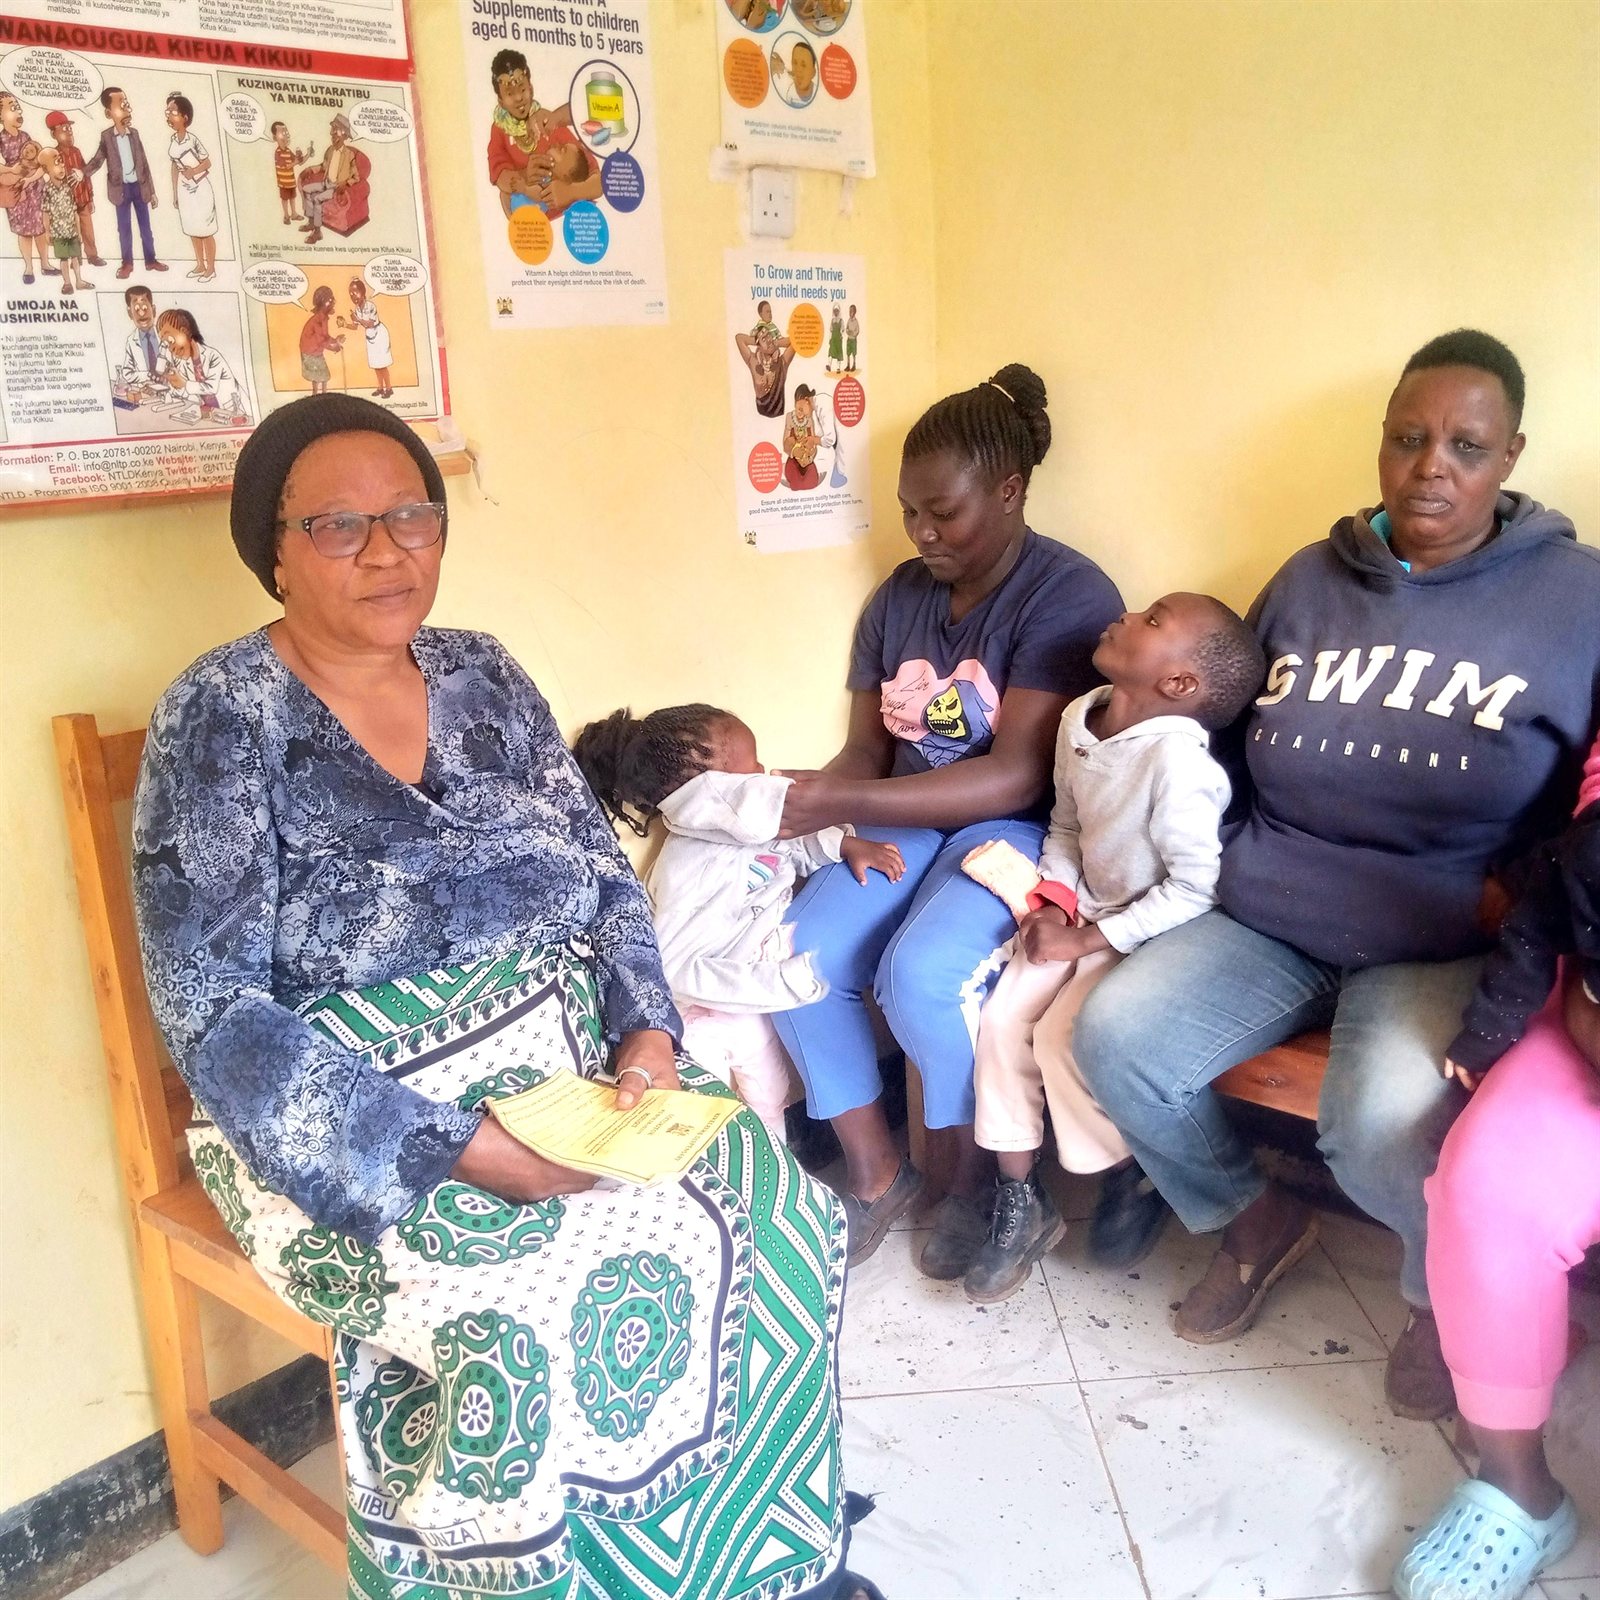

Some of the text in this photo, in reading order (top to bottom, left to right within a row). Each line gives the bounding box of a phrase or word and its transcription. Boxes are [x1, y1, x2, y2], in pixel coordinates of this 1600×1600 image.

[47, 5, 81, 15] matibabu
[162, 11, 170, 19] ya
[473, 0, 640, 34] Supplements to children
[472, 19, 644, 55] aged 6 months to 5 years
[167, 38, 237, 63] KIFUA
[244, 46, 313, 70] KIKUU
[16, 64, 84, 77] YANGU NA WAKATI
[13, 73, 90, 85] NILIKUWA NINAUGUA
[12, 80, 93, 93] KIFUA KIKUU HUENDA
[237, 78, 370, 99] KUZINGATIA UTARATIBU
[270, 93, 344, 108] YA MATIBABU
[592, 101, 620, 113] Vitamin A
[525, 269, 547, 277] Vitamin
[548, 269, 553, 277] A
[553, 269, 569, 278] helps
[569, 269, 592, 277] children
[753, 264, 843, 282] To Grow and Thrive
[511, 279, 533, 287] protect
[547, 279, 572, 287] eyesight
[751, 284, 847, 302] your child needs you
[6, 299, 78, 311] UMOJA NA
[0, 312, 89, 324] USHIRIKIANO
[15, 335, 41, 344] jukumu
[2, 341, 96, 352] kuchangia ushikamano kati
[3, 352, 12, 360] ya
[45, 350, 63, 358] Kifua
[64, 349, 84, 357] Kikuu
[19, 360, 45, 368] jukumu
[33, 376, 42, 384] ya
[7, 384, 45, 392] kusambaa
[62, 382, 91, 391] ugonjwa
[22, 408, 52, 416] harakati
[63, 405, 104, 415] kuangamiza
[25, 400, 51, 409] jukumu
[33, 415, 54, 424] Kikuu
[56, 452, 65, 462] P.
[68, 451, 79, 461] O.
[82, 450, 101, 460] Box
[102, 445, 162, 459] 20781-00202
[49, 464, 81, 475] Email:
[83, 458, 154, 473] info@nltp.co.ke
[155, 454, 197, 466] Website:
[52, 474, 106, 486] Facebook:
[108, 469, 164, 482] NTLDKenya
[165, 465, 200, 477] Twitter:
[34, 488, 77, 499] Program
[79, 485, 88, 494] is
[89, 484, 109, 494] ISO
[748, 508, 760, 516] good
[803, 503, 812, 511] play
[820, 500, 841, 508] protection
[1255, 644, 1529, 731] SWIM
[1253, 728, 1468, 770] CLAIBORNE
